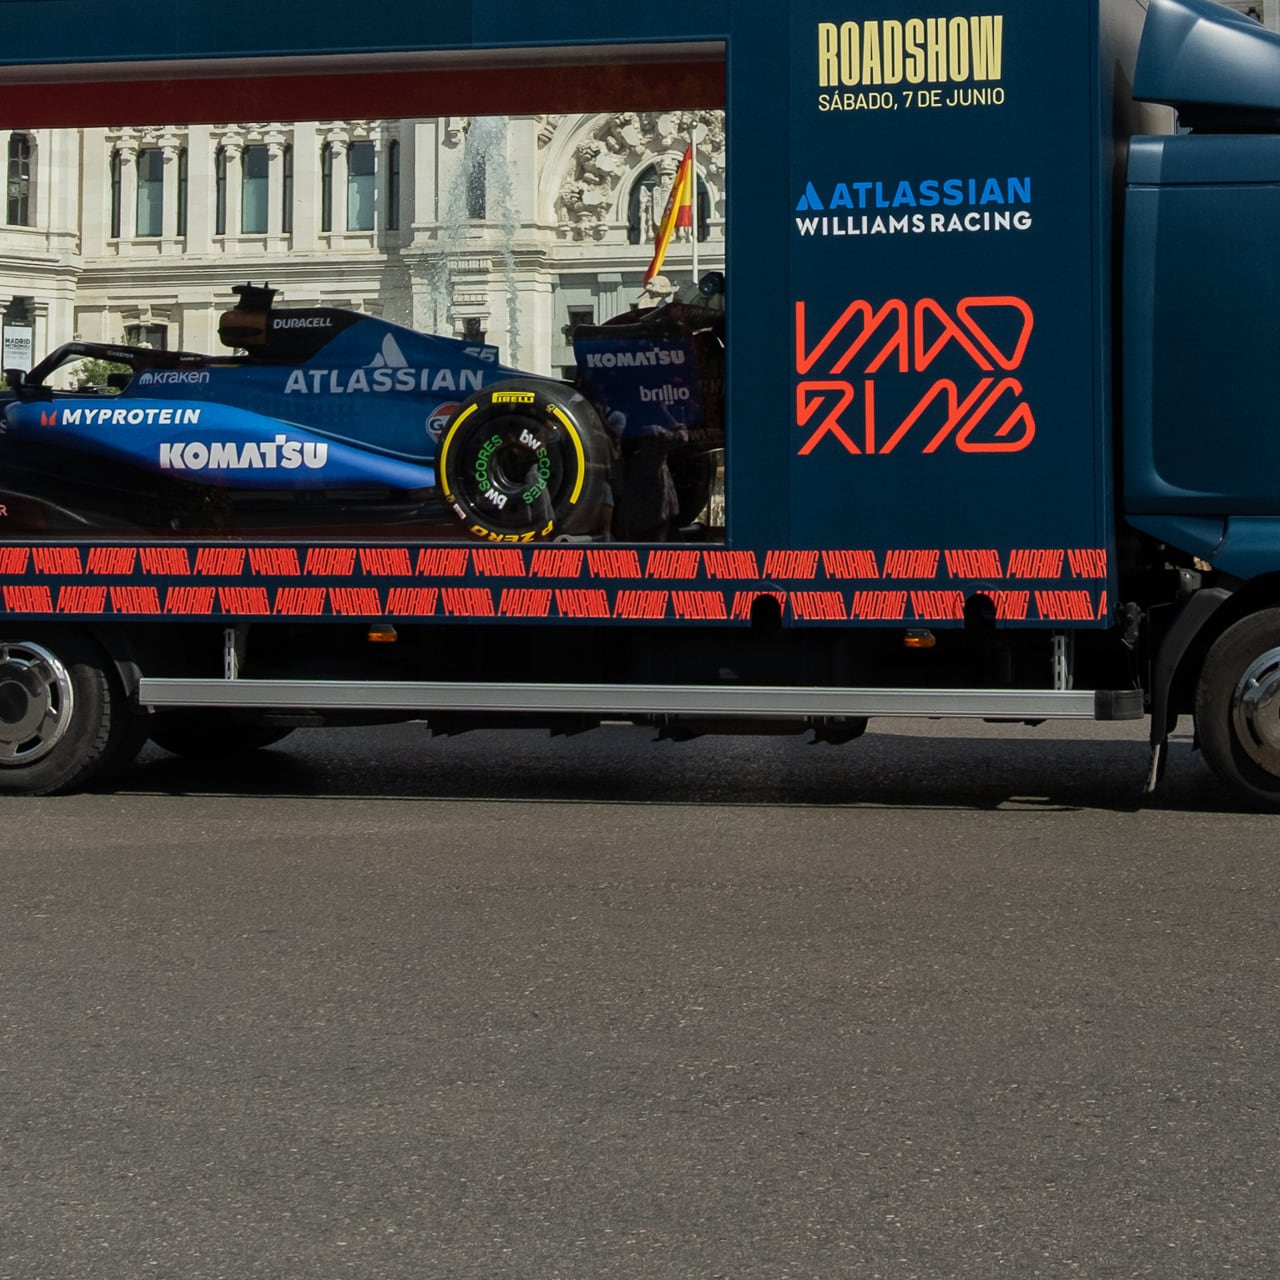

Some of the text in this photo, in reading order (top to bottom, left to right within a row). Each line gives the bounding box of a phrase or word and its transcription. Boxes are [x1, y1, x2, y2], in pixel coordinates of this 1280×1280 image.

[817, 15, 1004, 87] ROADSHOW
[818, 87, 1005, 112] SÁBADO, 7 DE JUNIO
[829, 177, 1031, 210] ATLASSIAN
[796, 211, 1032, 236] WILLIAMS RACING
[273, 317, 333, 329] DURACELL
[586, 347, 685, 367] KOMATSU
[284, 368, 484, 394] ATLASSIAN
[492, 392, 535, 403] PIRELLI
[62, 408, 201, 425] MYPROTEIN
[159, 434, 328, 469] KOMATSU
[475, 434, 503, 491] SCORES
[522, 448, 551, 504] SCORES
[470, 525, 536, 543] ZERO
[32, 548, 82, 574] MADRING
[86, 548, 136, 574] MADRING
[139, 548, 190, 575] MADRING
[194, 548, 246, 575] MADRING
[248, 548, 300, 575] MADRING
[304, 548, 356, 575] MADRING
[359, 549, 412, 576] MADRING
[416, 549, 469, 576] MADRING
[472, 549, 526, 576] MADRING
[529, 550, 584, 577] MADRING
[587, 550, 641, 578] MADRING
[645, 551, 700, 578] MADRING
[703, 551, 759, 579] MADRING
[763, 551, 819, 578] MADRING
[822, 550, 879, 578] MADRING
[883, 550, 939, 578] MADRING
[945, 550, 1002, 578] MADRING
[1006, 550, 1064, 578] MADRING
[1068, 549, 1106, 578] MADR
[3, 586, 53, 613] MADRING
[56, 586, 107, 613] MADRING
[110, 587, 161, 614] MADRING
[164, 587, 215, 614] MADRING
[218, 587, 270, 614] MADRING
[273, 588, 326, 615] MADRING
[329, 588, 382, 615] MADRING
[385, 588, 438, 615] MADRING
[442, 588, 494, 616] MADRING
[498, 589, 552, 616] MADRING
[555, 589, 610, 617] MADRING
[613, 591, 668, 618] MADRING
[672, 591, 727, 619] MADRING
[790, 592, 847, 619] MADRING
[851, 591, 907, 619] MADRING
[975, 591, 1030, 620] DRING
[1035, 591, 1094, 620] MADRING
